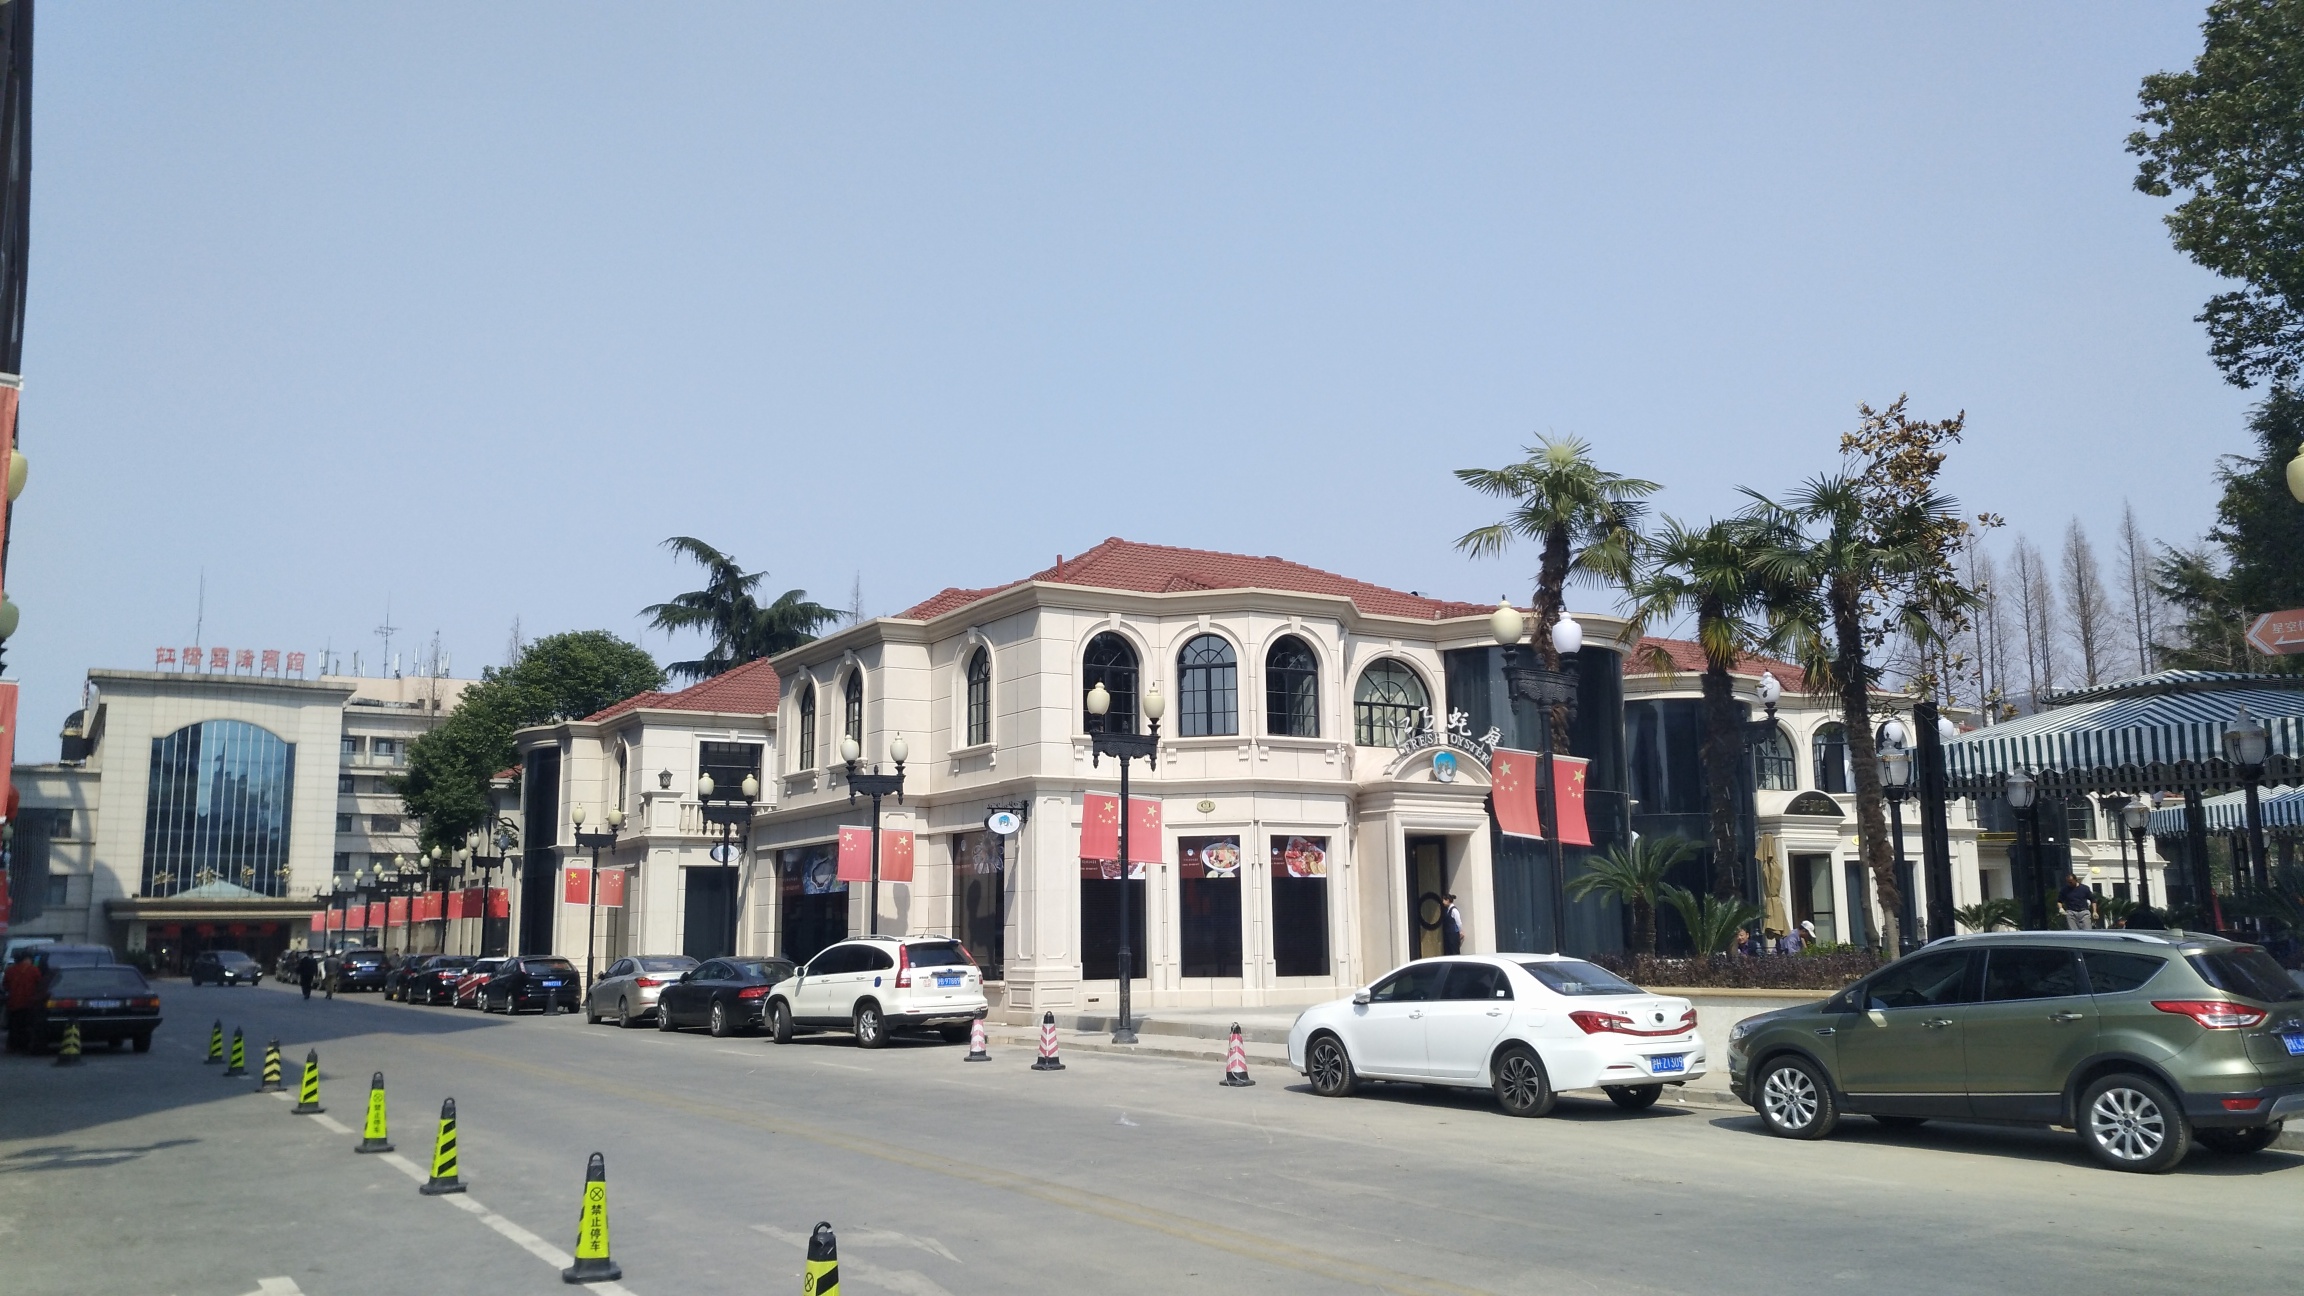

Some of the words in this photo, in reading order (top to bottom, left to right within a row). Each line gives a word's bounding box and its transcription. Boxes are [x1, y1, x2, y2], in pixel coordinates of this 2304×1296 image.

[1403, 732, 1441, 755] FRESH
[1450, 733, 1492, 766] OYSTER
[590, 1204, 602, 1252] 禁止停车
